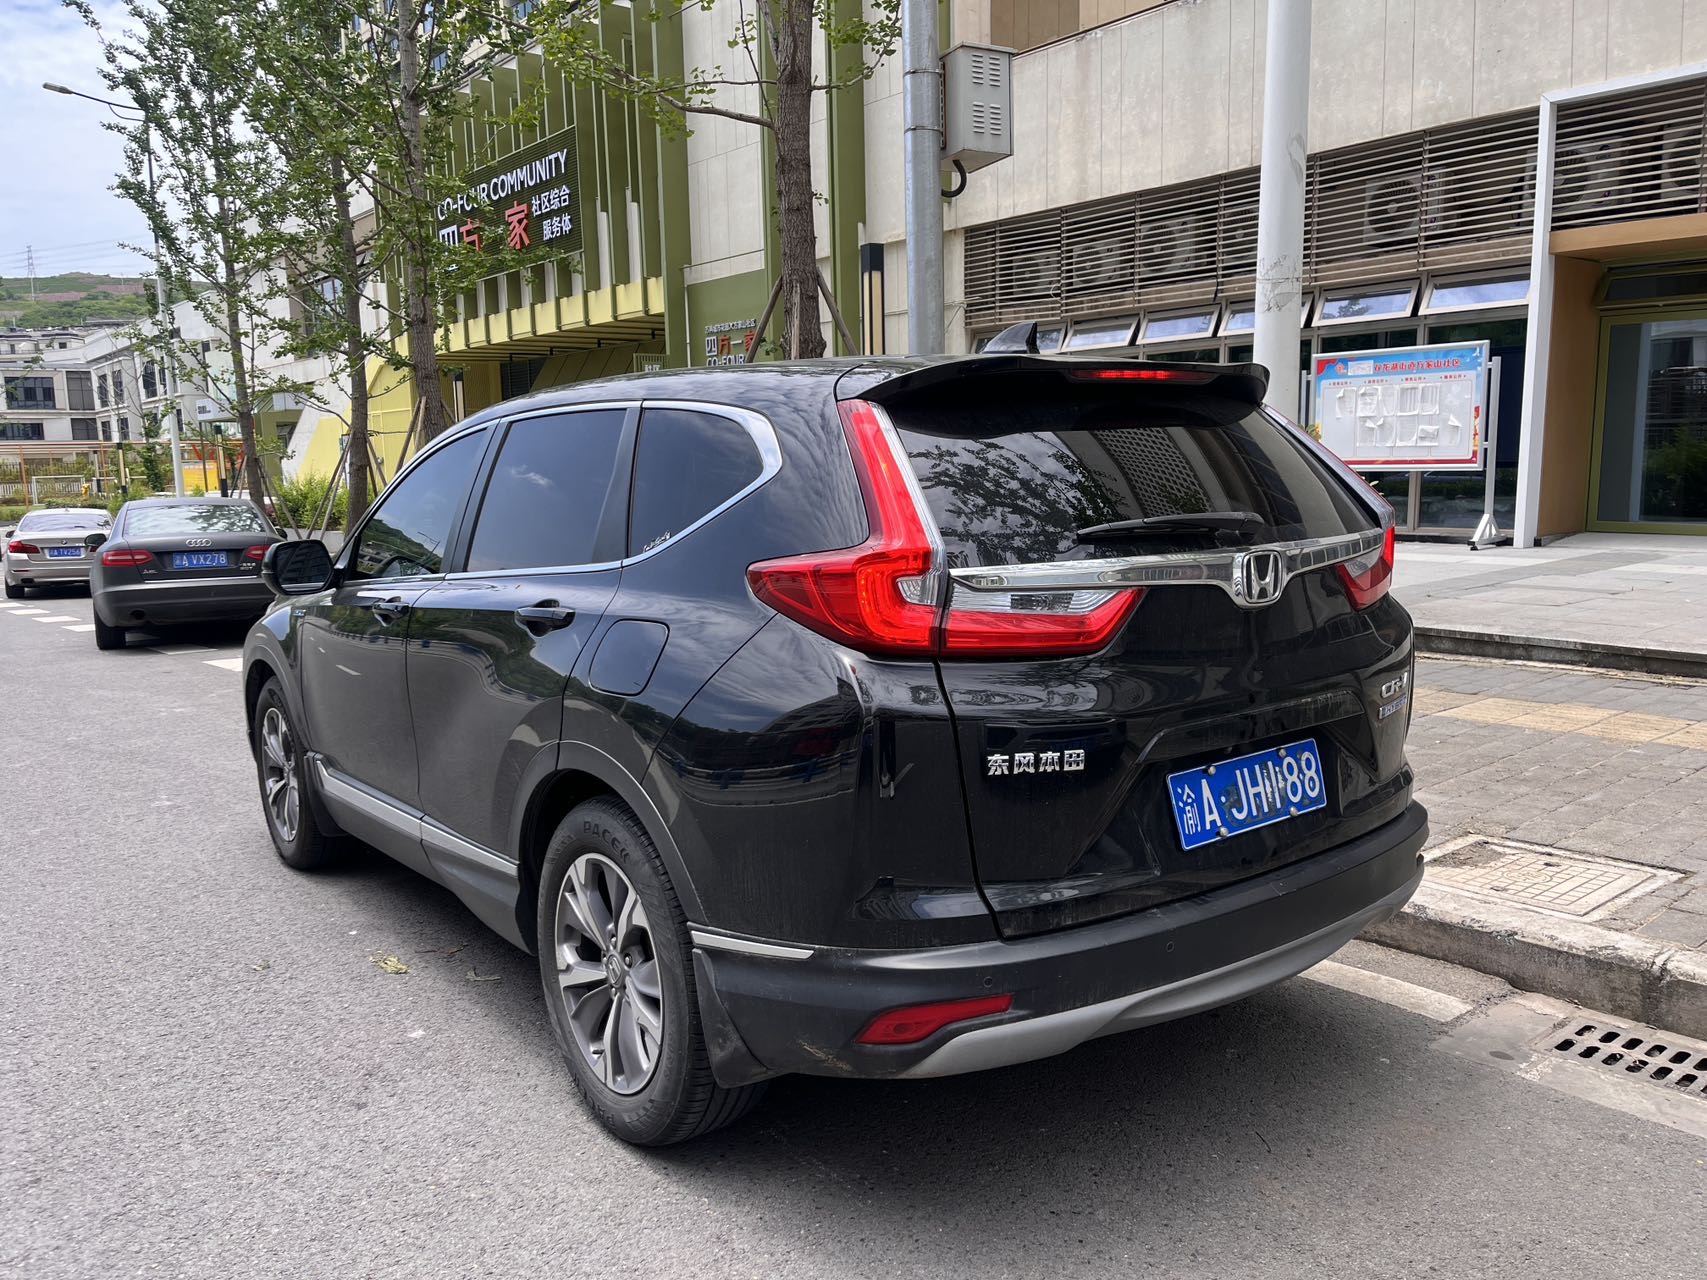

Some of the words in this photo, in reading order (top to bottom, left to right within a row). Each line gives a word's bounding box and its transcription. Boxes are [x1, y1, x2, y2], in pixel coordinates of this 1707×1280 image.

[490, 148, 568, 201] COMMUNITY
[531, 184, 571, 217] 社区综合
[542, 212, 572, 241] 服务体
[986, 748, 1085, 776] 东风本田
